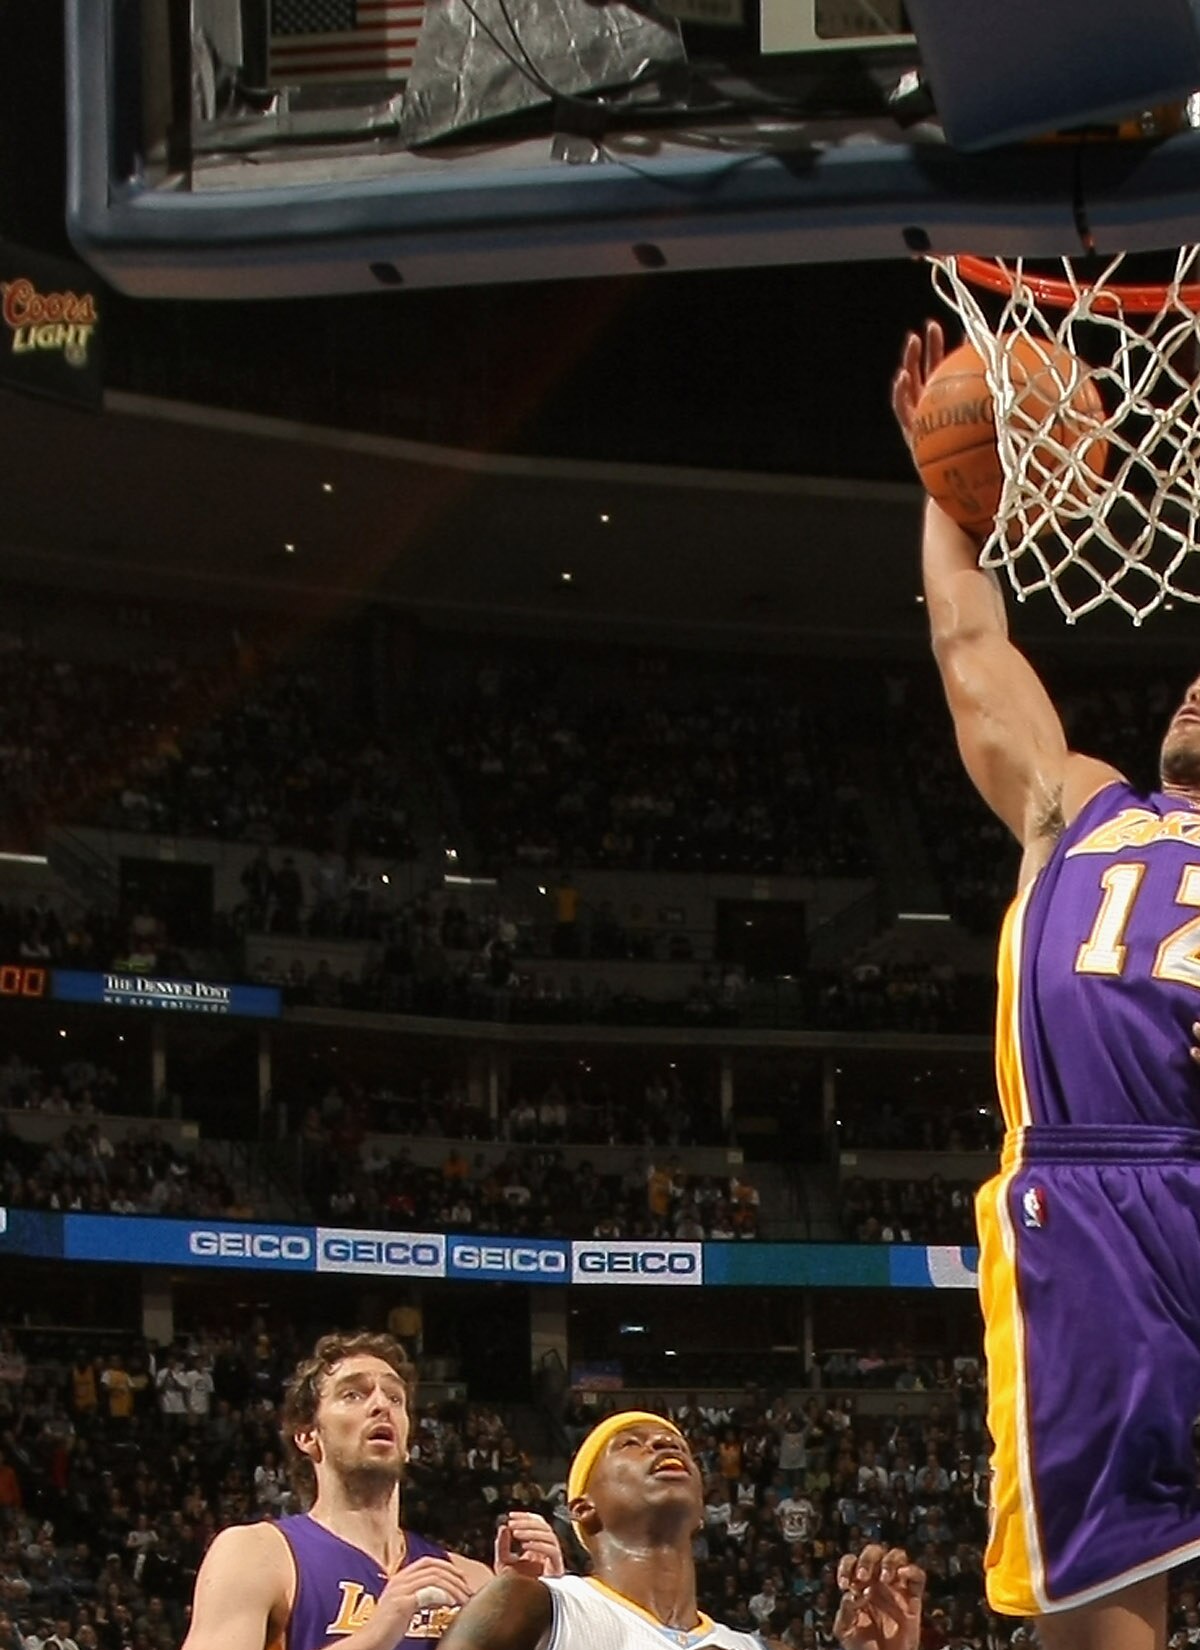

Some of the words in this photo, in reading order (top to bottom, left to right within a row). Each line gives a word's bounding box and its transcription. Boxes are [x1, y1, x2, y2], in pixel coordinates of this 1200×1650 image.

[12, 324, 93, 351] LIGHT
[189, 1231, 311, 1261] GEICO
[322, 1237, 440, 1268] GEICO
[453, 1244, 566, 1273] GEICO
[577, 1251, 697, 1275] GEICO
